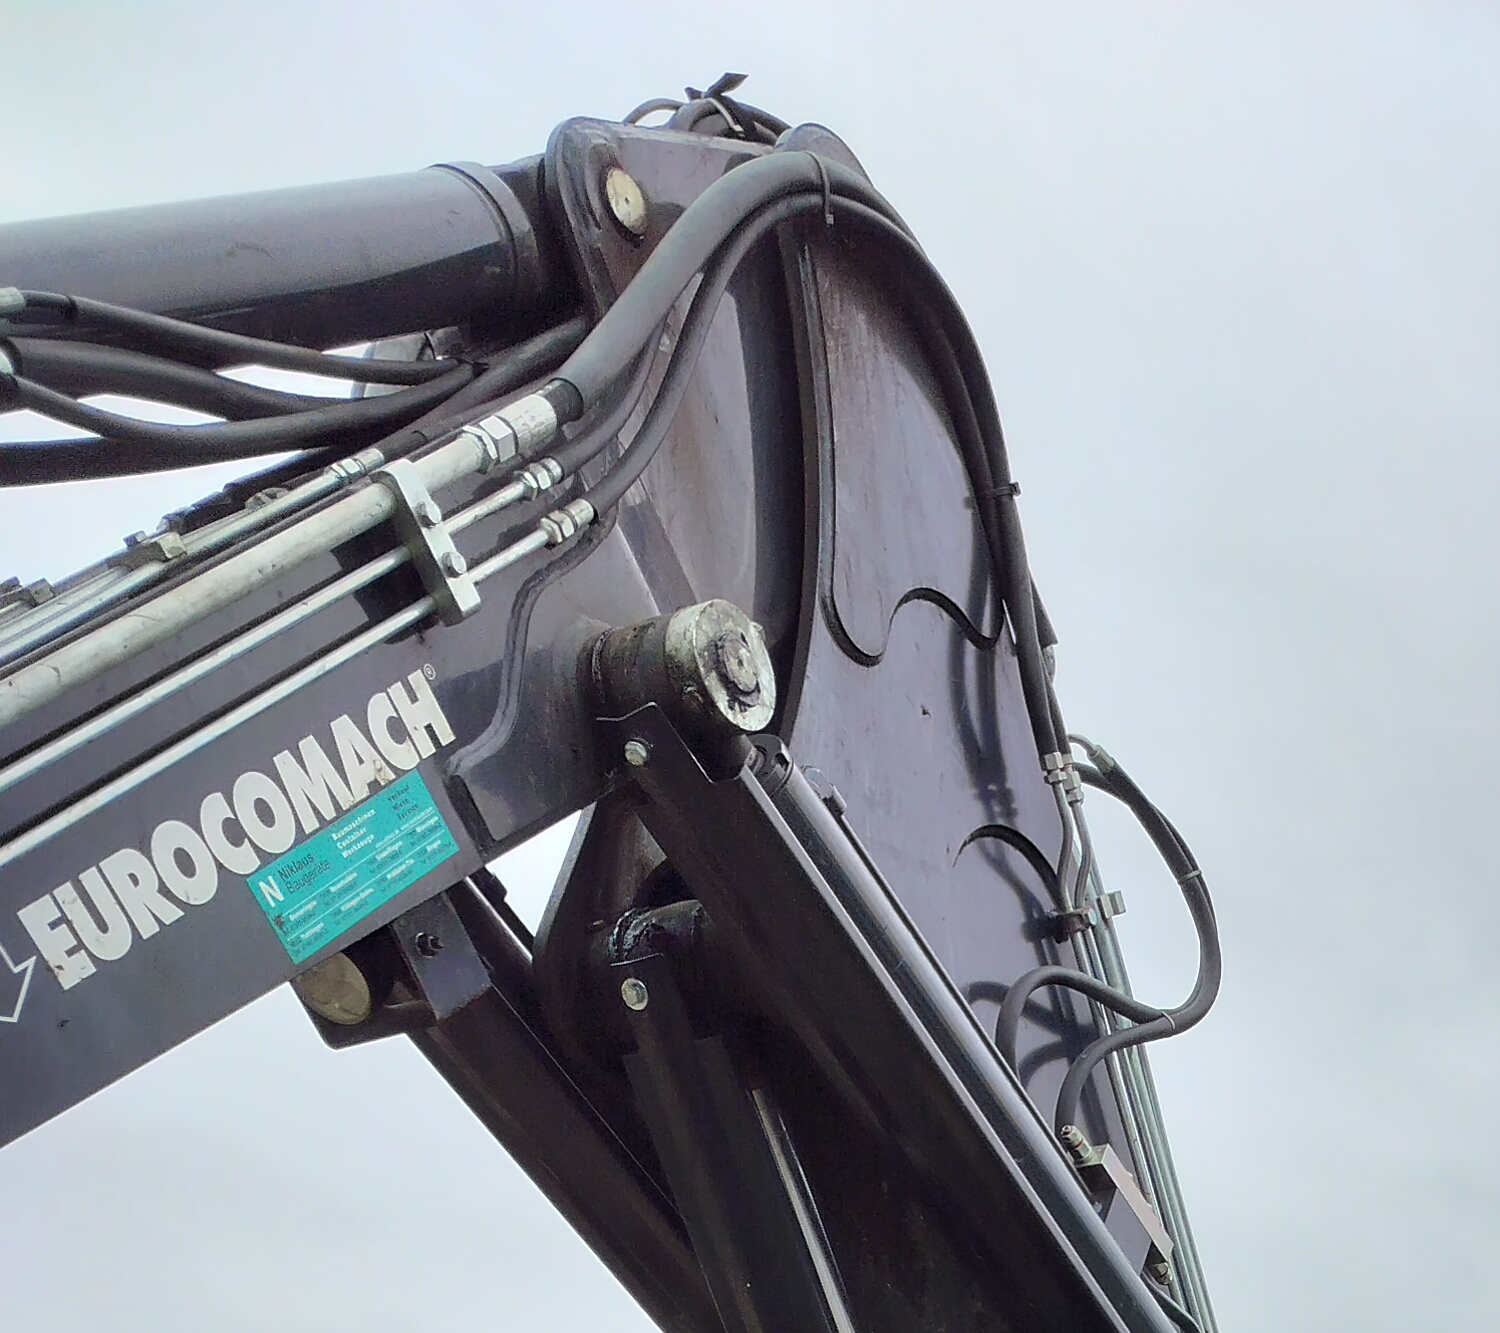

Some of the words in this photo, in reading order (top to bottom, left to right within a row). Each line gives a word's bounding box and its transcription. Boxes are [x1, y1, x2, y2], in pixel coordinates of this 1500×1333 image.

[17, 668, 456, 990] EUROCOMACH
[278, 853, 315, 882] Niklaus
[285, 860, 332, 894] Baugeräte
[258, 876, 284, 907] N
